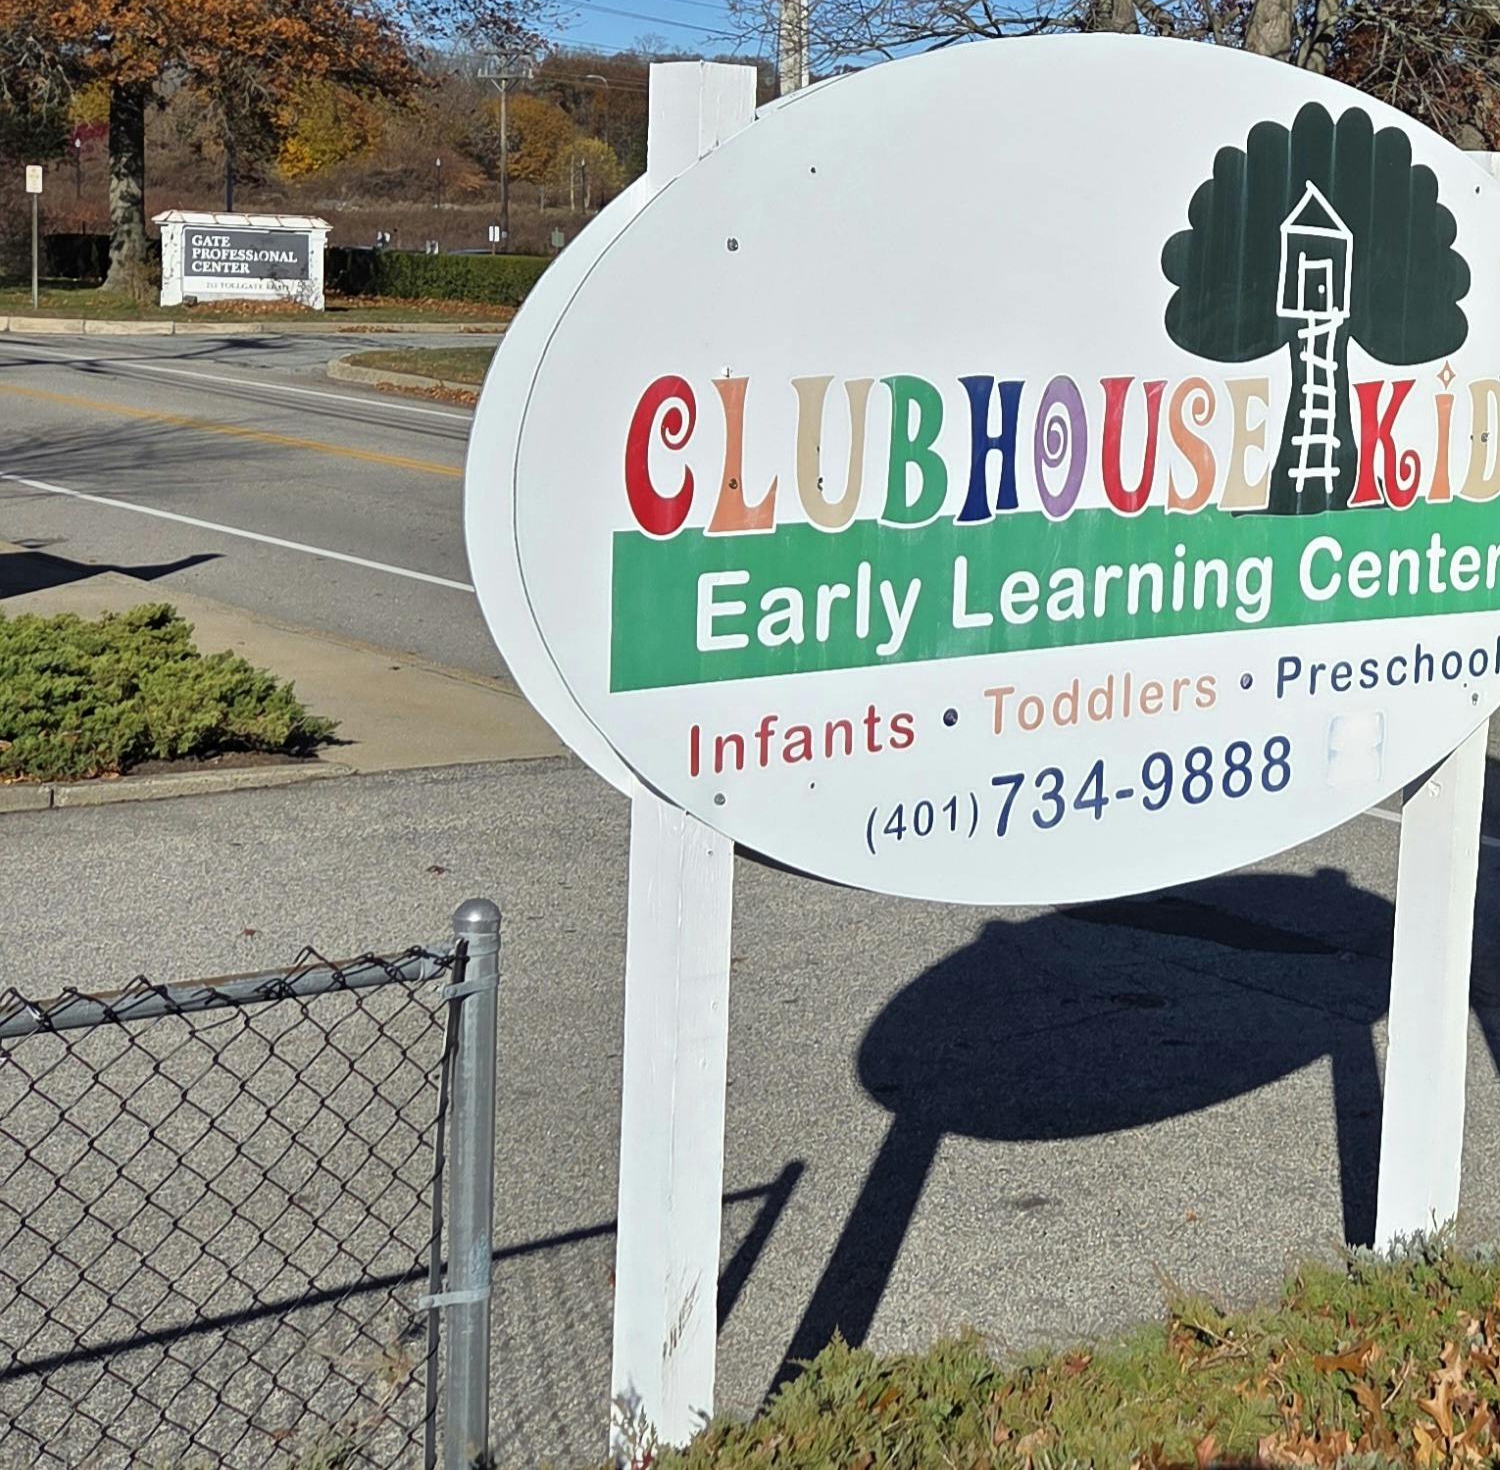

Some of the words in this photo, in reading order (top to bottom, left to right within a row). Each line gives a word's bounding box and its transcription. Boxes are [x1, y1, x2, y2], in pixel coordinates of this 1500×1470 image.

[191, 234, 231, 248] GATE
[191, 248, 298, 263] PROFESSIONAL
[191, 261, 250, 274] CENTER
[624, 374, 1272, 536] CLUBHOUSE
[696, 560, 921, 657] Early
[952, 543, 1274, 629] Learning
[688, 704, 915, 777] Infants
[983, 672, 1218, 734] Toddlers
